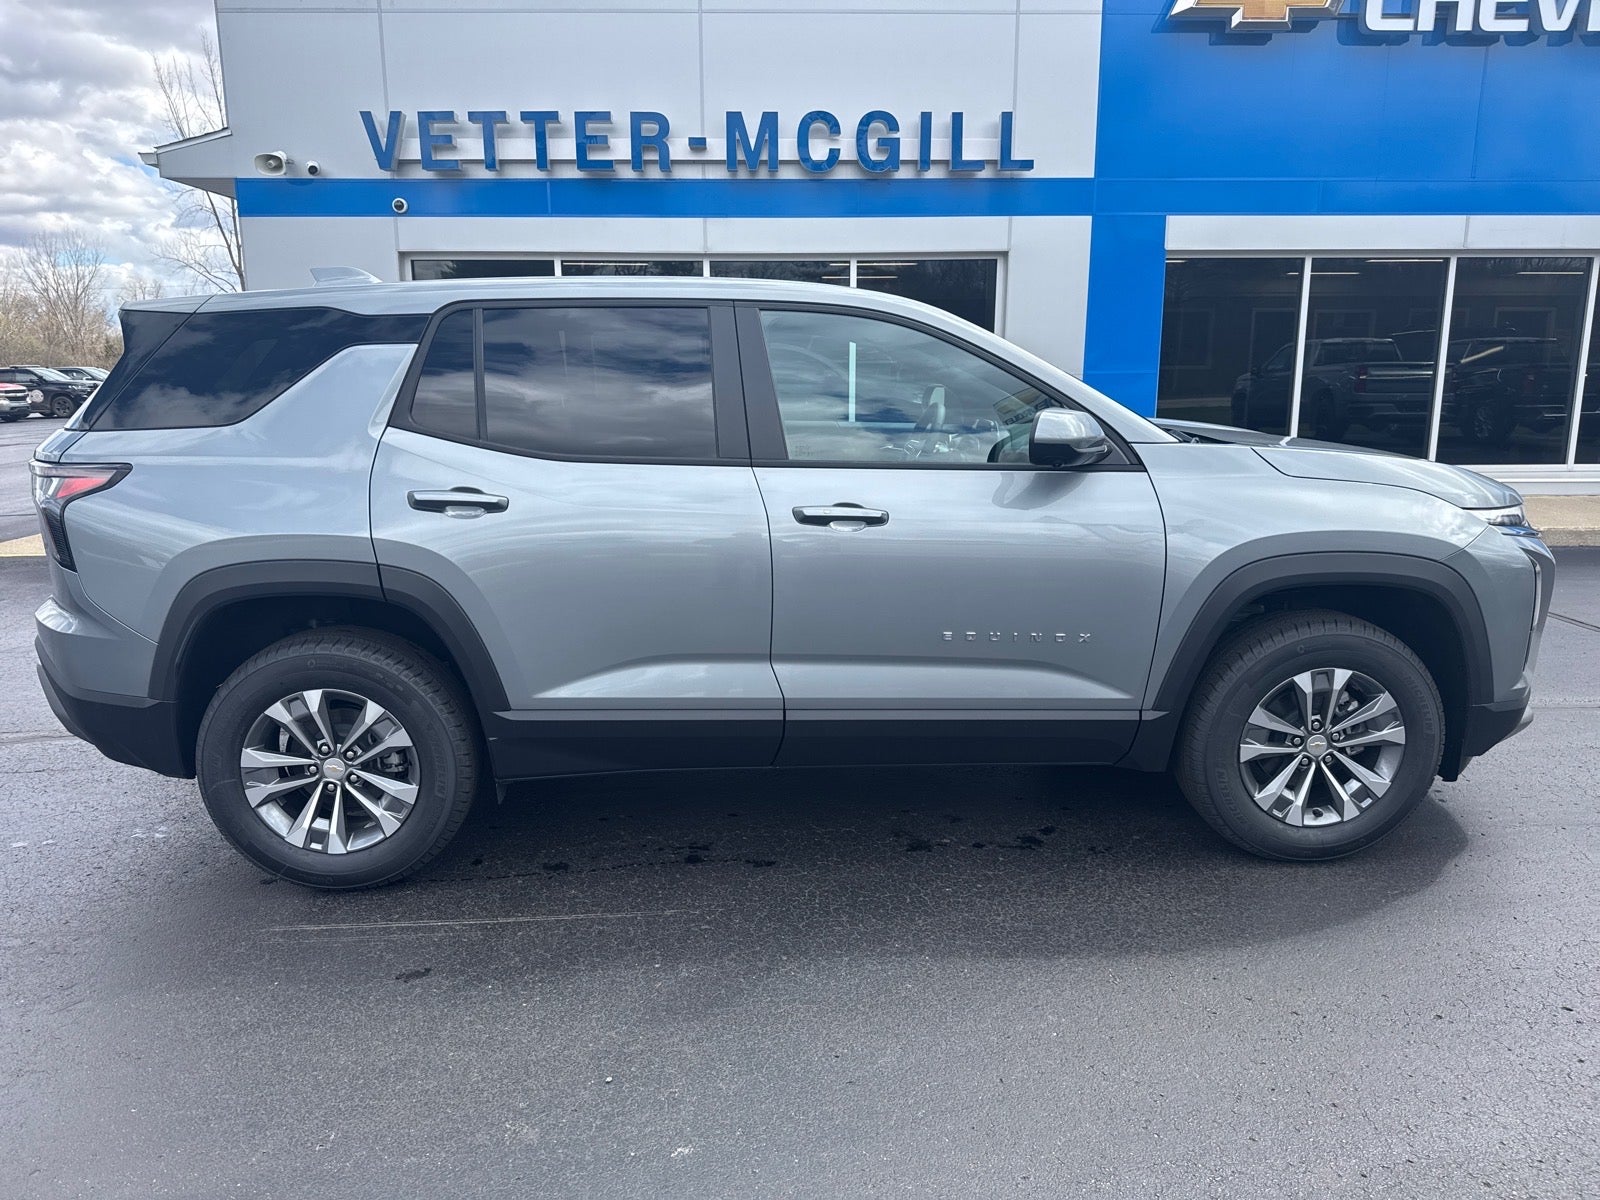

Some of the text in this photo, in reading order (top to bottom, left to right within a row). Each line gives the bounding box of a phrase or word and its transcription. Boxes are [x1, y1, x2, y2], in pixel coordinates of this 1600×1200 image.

[1365, 0, 1600, 32] CHEV
[359, 110, 1034, 173] VETTER-MCGILL
[943, 631, 1091, 643] EQUINOX
